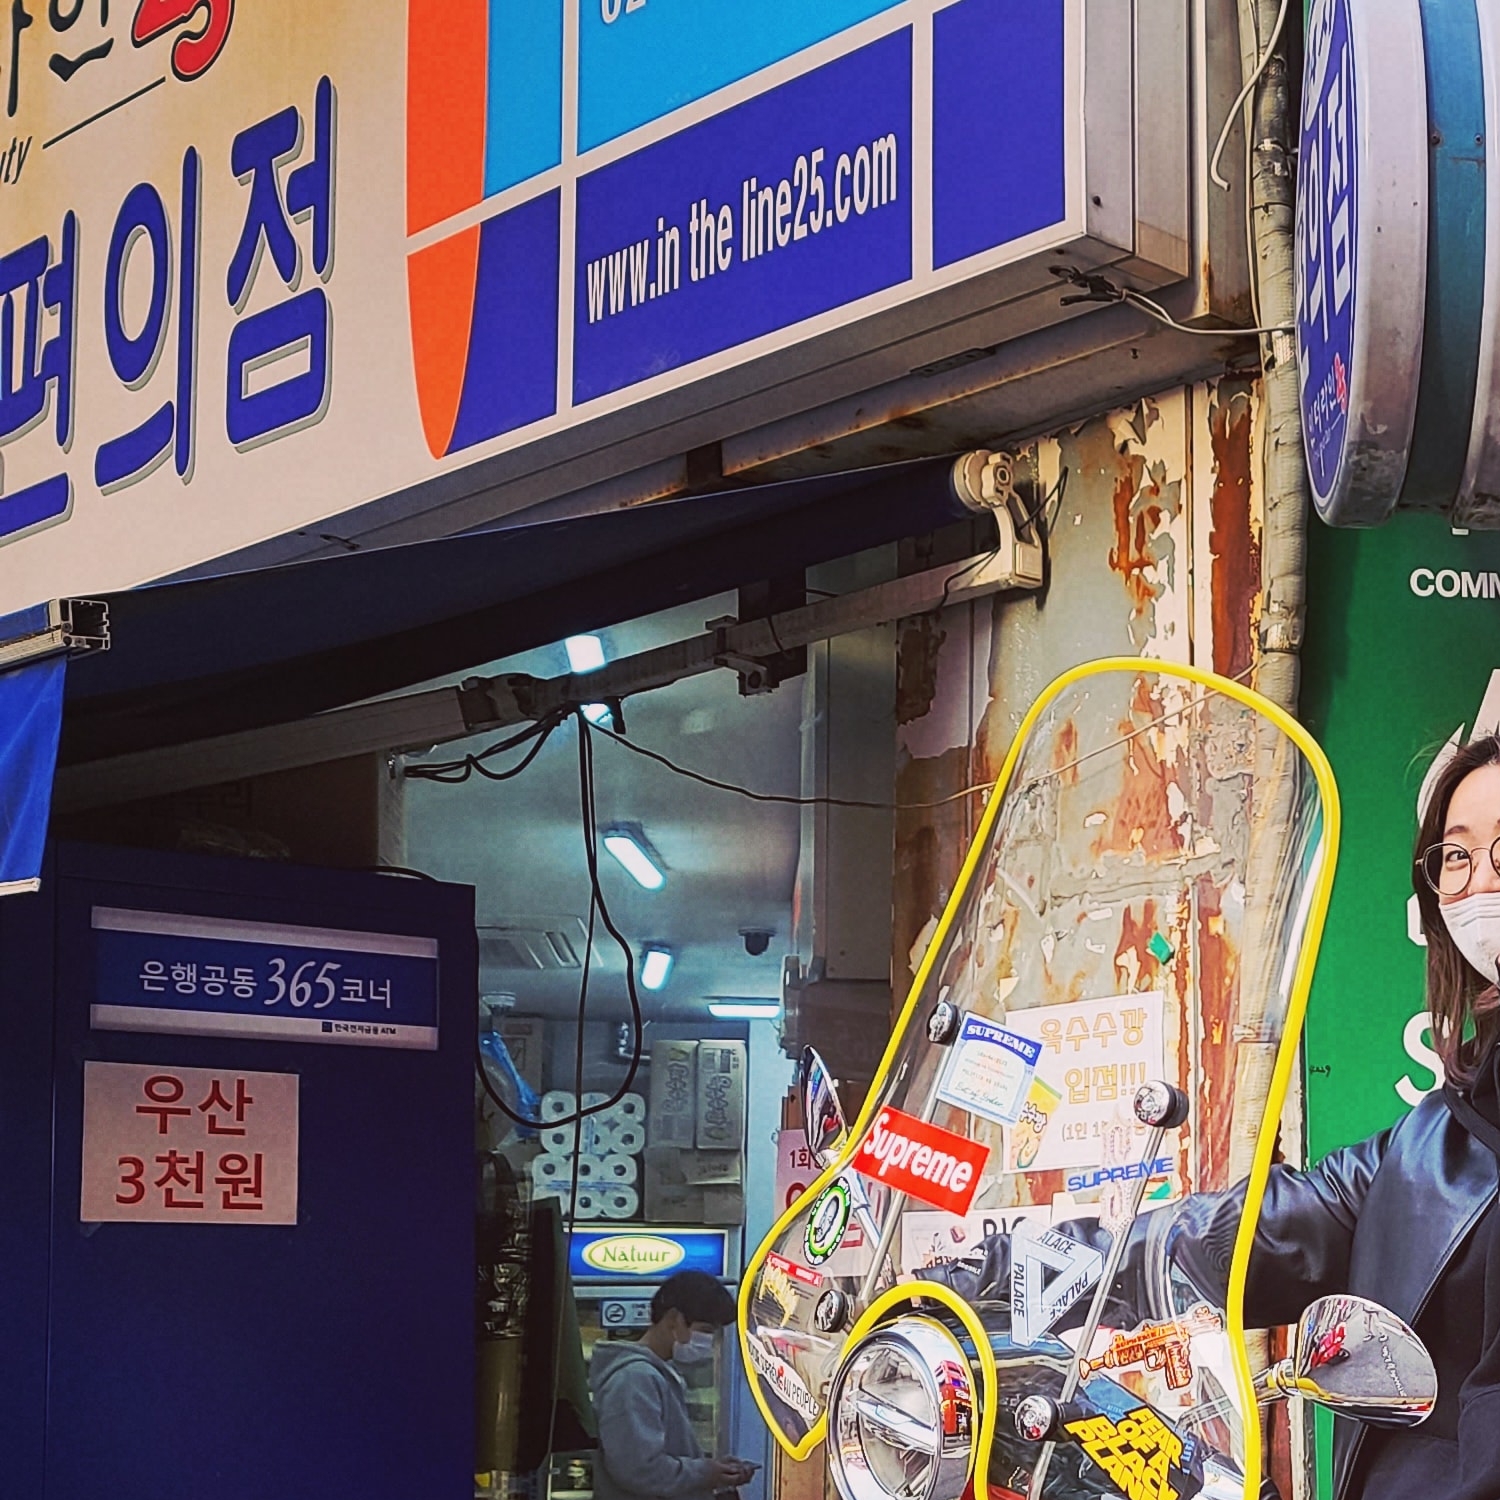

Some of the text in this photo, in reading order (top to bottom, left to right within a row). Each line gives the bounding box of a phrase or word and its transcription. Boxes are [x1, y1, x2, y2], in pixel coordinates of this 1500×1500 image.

[587, 133, 897, 324] www.in the line25.com
[139, 957, 392, 1009] 은행공동 365 코너
[966, 1024, 1036, 1059] SUPREME
[1040, 1008, 1148, 1054] 옥수수깡
[135, 1075, 254, 1136] 우산
[863, 1112, 973, 1192] Supreme
[1067, 1156, 1174, 1193] SUPREME
[115, 1150, 265, 1211] 3천원
[1037, 1231, 1076, 1256] ALACE
[1013, 1261, 1025, 1318] PALACE
[1117, 1419, 1157, 1454] OF
[1128, 1407, 1182, 1469] FEAR
